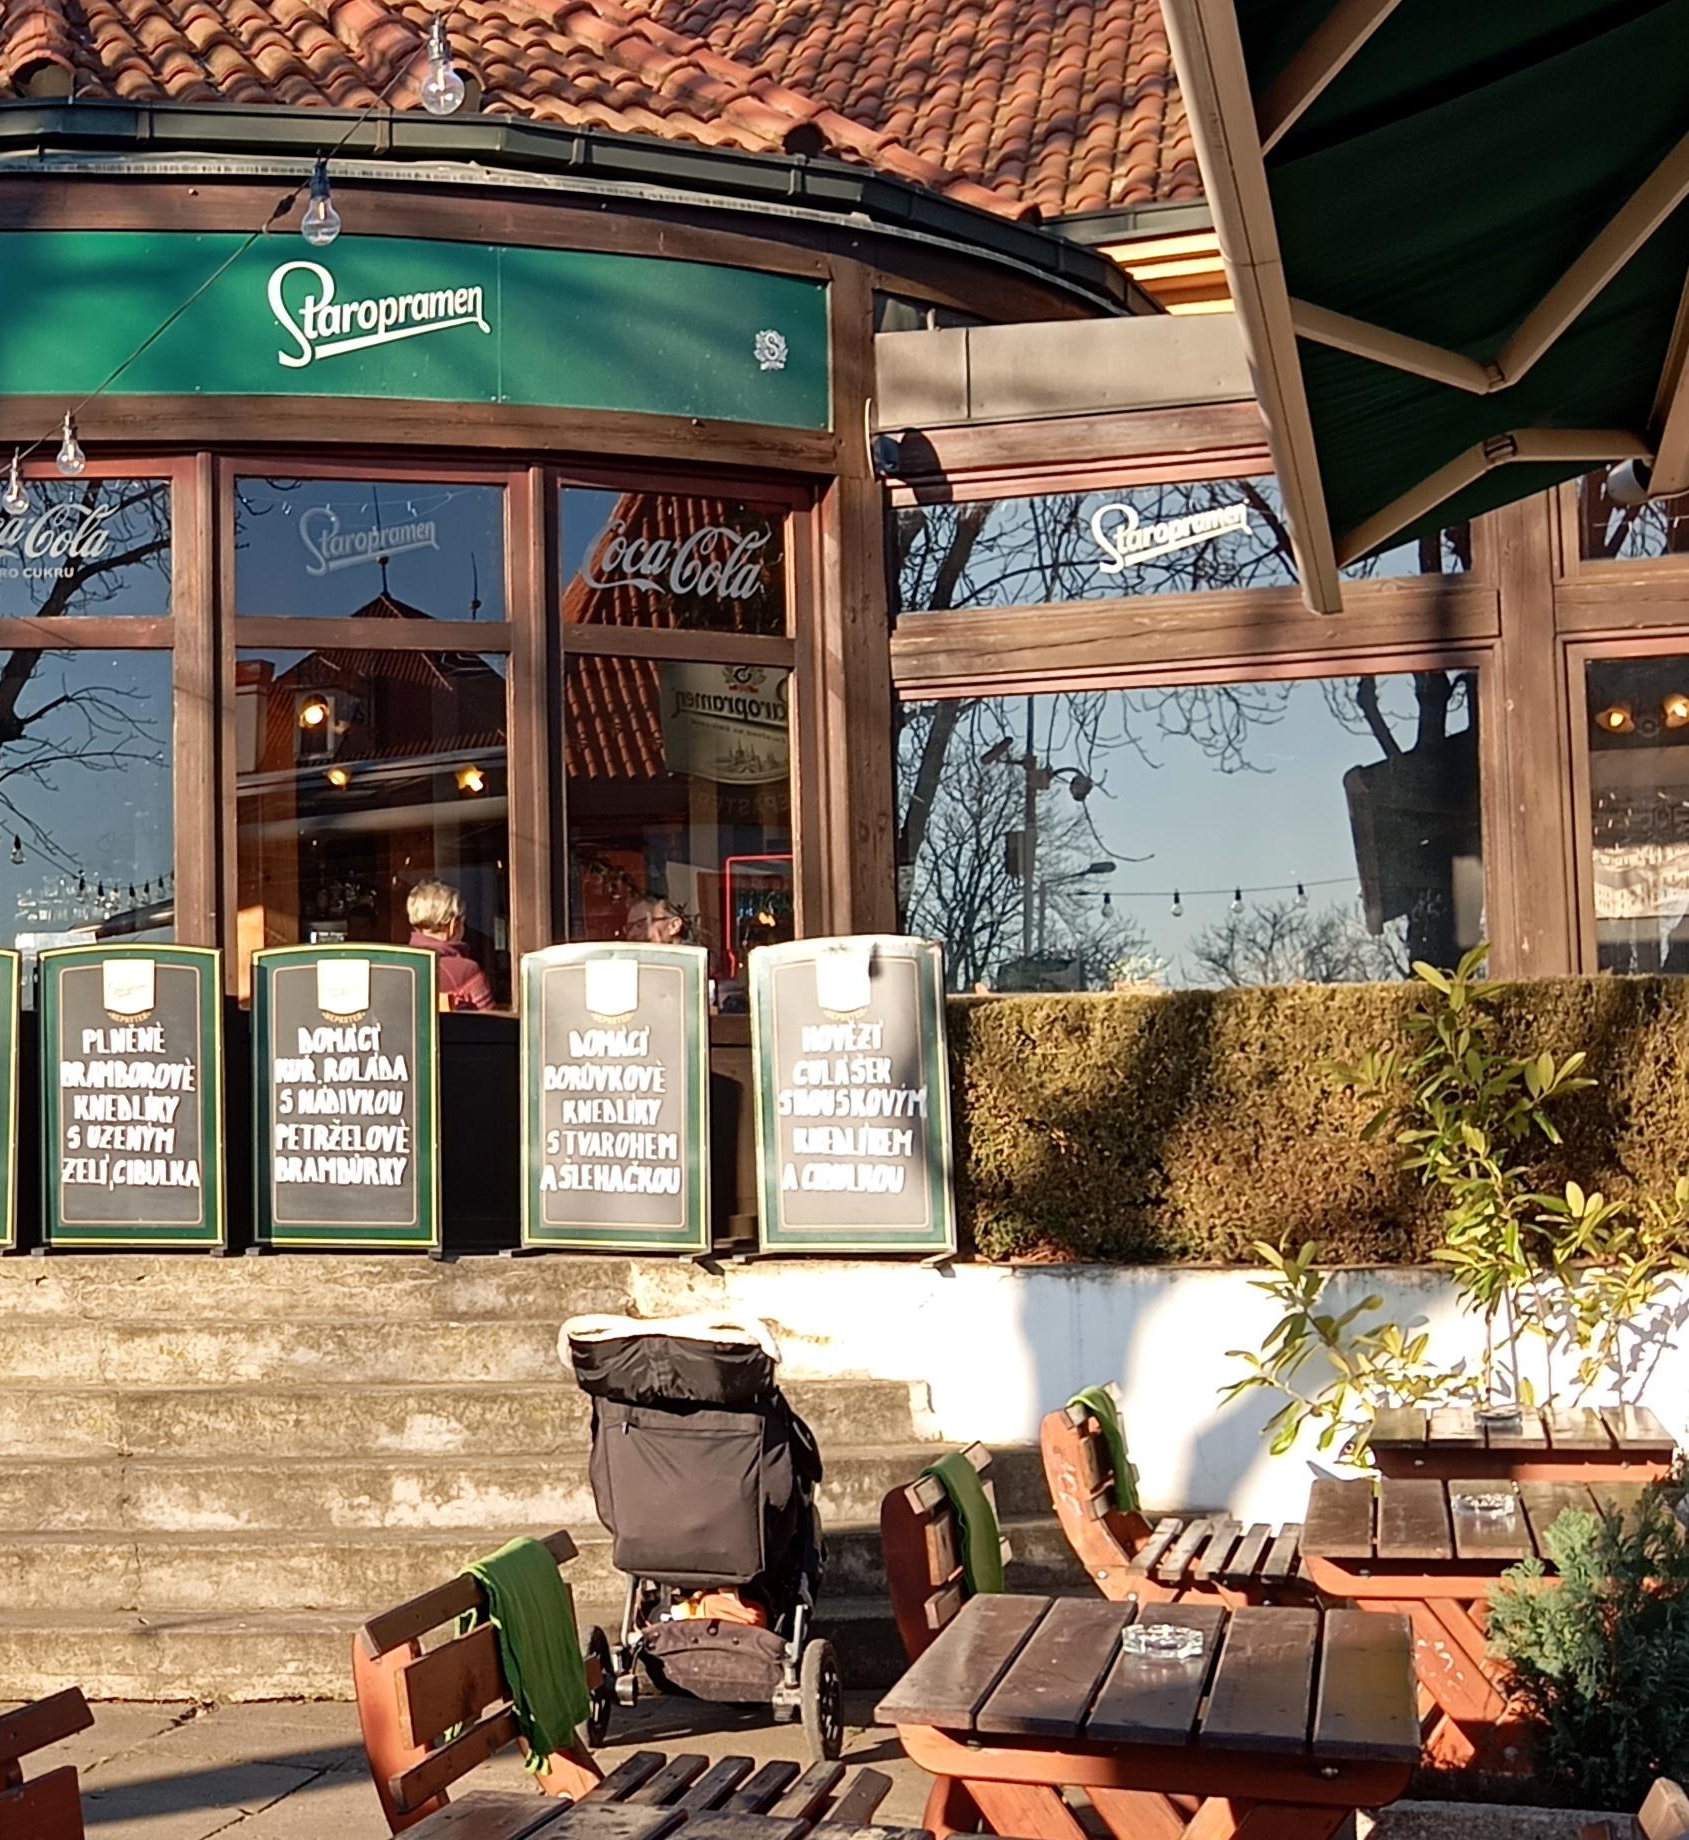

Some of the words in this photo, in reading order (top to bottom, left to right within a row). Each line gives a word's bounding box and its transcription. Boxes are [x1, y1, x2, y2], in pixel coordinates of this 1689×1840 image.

[268, 261, 492, 367] Staropramen
[299, 507, 439, 576] Staropramen
[1091, 498, 1253, 574] Staropramen
[22, 566, 74, 580] CUKRU
[581, 519, 772, 600] Coca-Cola
[279, 1088, 293, 1114] S
[67, 1125, 81, 1150] S
[546, 1130, 560, 1155] S
[562, 1130, 678, 1161] TVAROHEM
[540, 1164, 557, 1192] A
[782, 1163, 798, 1191] A
